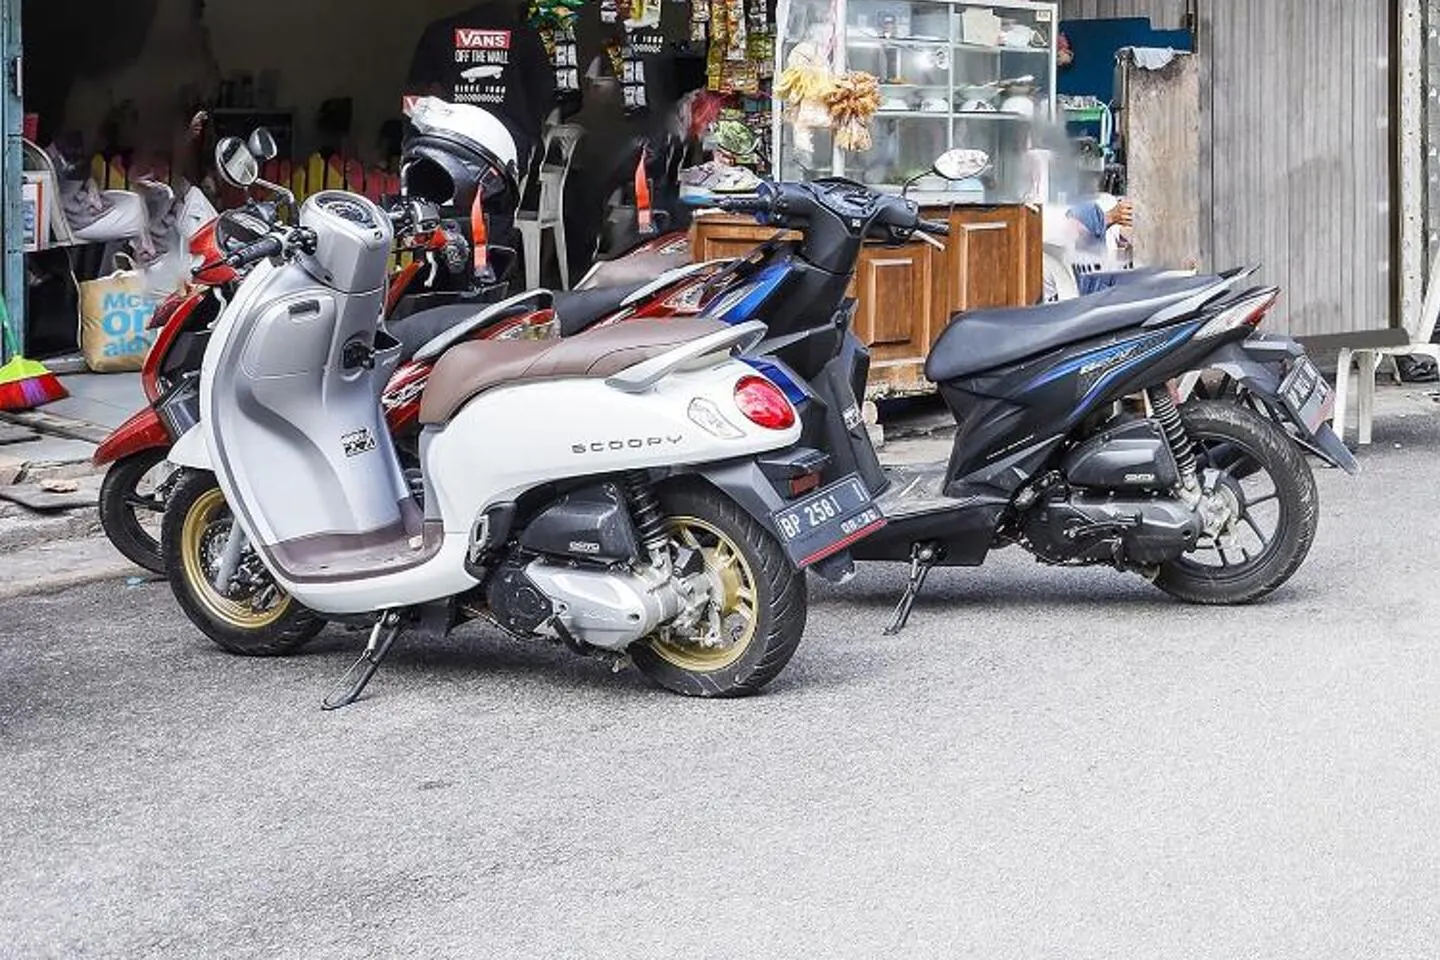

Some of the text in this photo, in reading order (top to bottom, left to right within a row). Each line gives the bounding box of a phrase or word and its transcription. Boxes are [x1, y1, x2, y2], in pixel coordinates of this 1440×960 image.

[458, 30, 506, 47] VANS
[454, 49, 509, 64] OFF THE WALL
[571, 435, 682, 454] SCOOPY
[780, 514, 802, 538] BP
[804, 495, 842, 527] 2581
